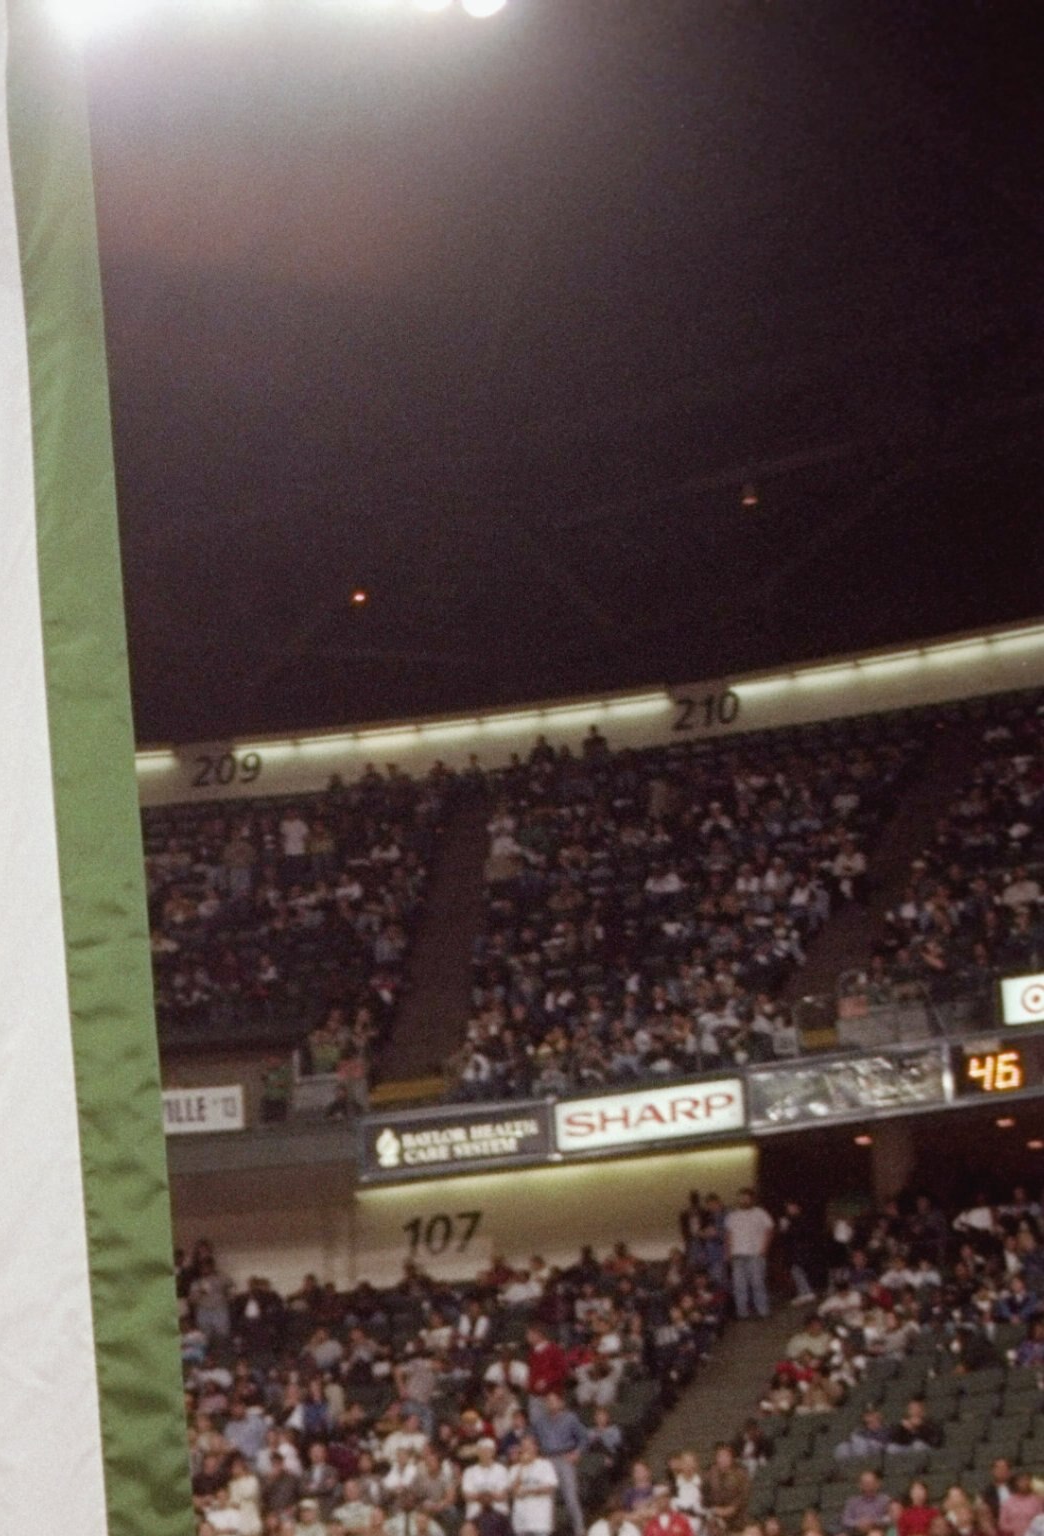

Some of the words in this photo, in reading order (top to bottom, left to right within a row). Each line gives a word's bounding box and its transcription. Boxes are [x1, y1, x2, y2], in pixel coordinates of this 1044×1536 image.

[672, 690, 740, 731] 210
[191, 752, 262, 788] 209
[968, 1052, 1022, 1092] 46
[564, 1091, 734, 1138] SHARP
[402, 1210, 482, 1257] 107
